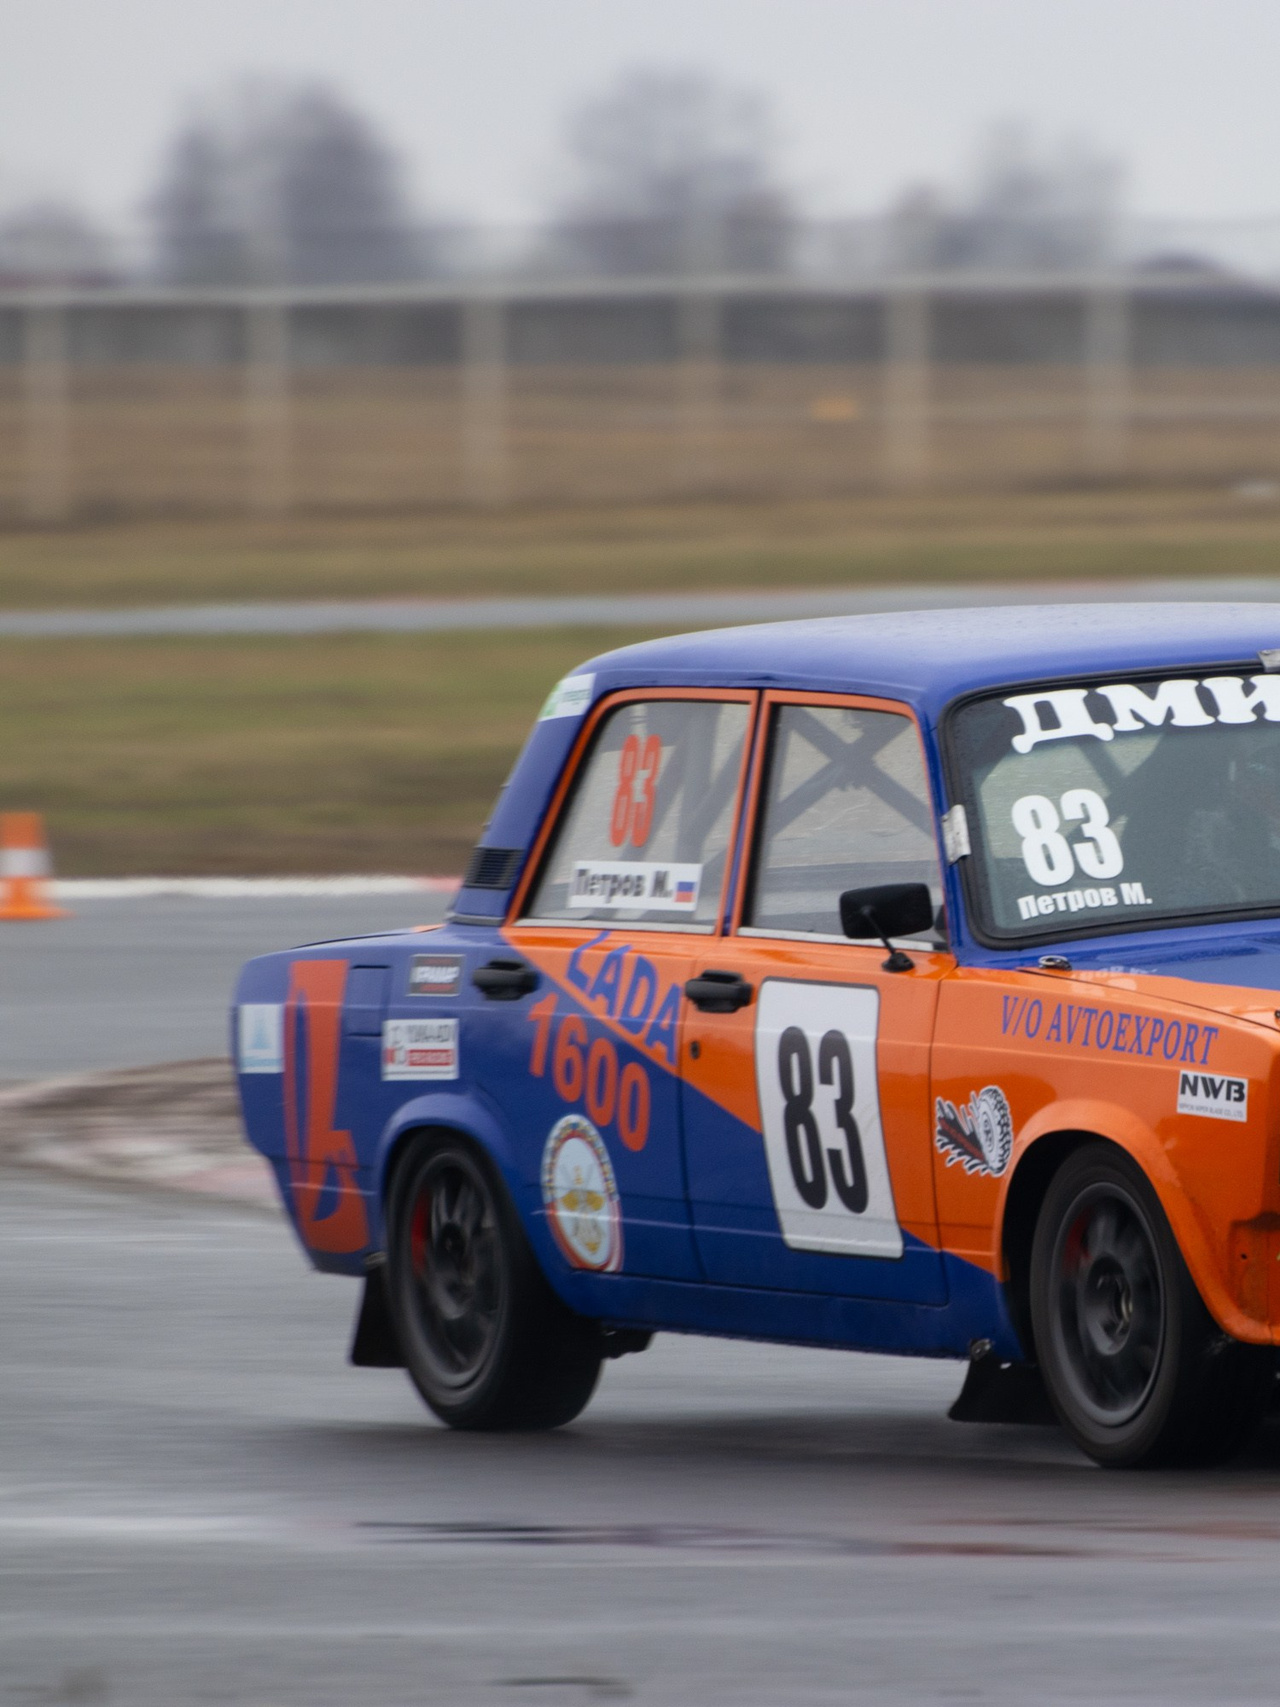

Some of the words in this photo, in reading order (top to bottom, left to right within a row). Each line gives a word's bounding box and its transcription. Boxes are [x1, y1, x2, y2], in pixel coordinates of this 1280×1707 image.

[610, 736, 662, 847] 83
[1011, 789, 1124, 886] 83
[572, 869, 645, 903] Петров
[1120, 882, 1153, 905] М.
[565, 930, 684, 1064] LADA
[1001, 996, 1042, 1038] V/O
[1046, 1003, 1218, 1064] AVTOEXPORT
[527, 993, 651, 1152] 1600
[778, 1026, 868, 1214] 83
[1181, 1074, 1245, 1102] NWB
